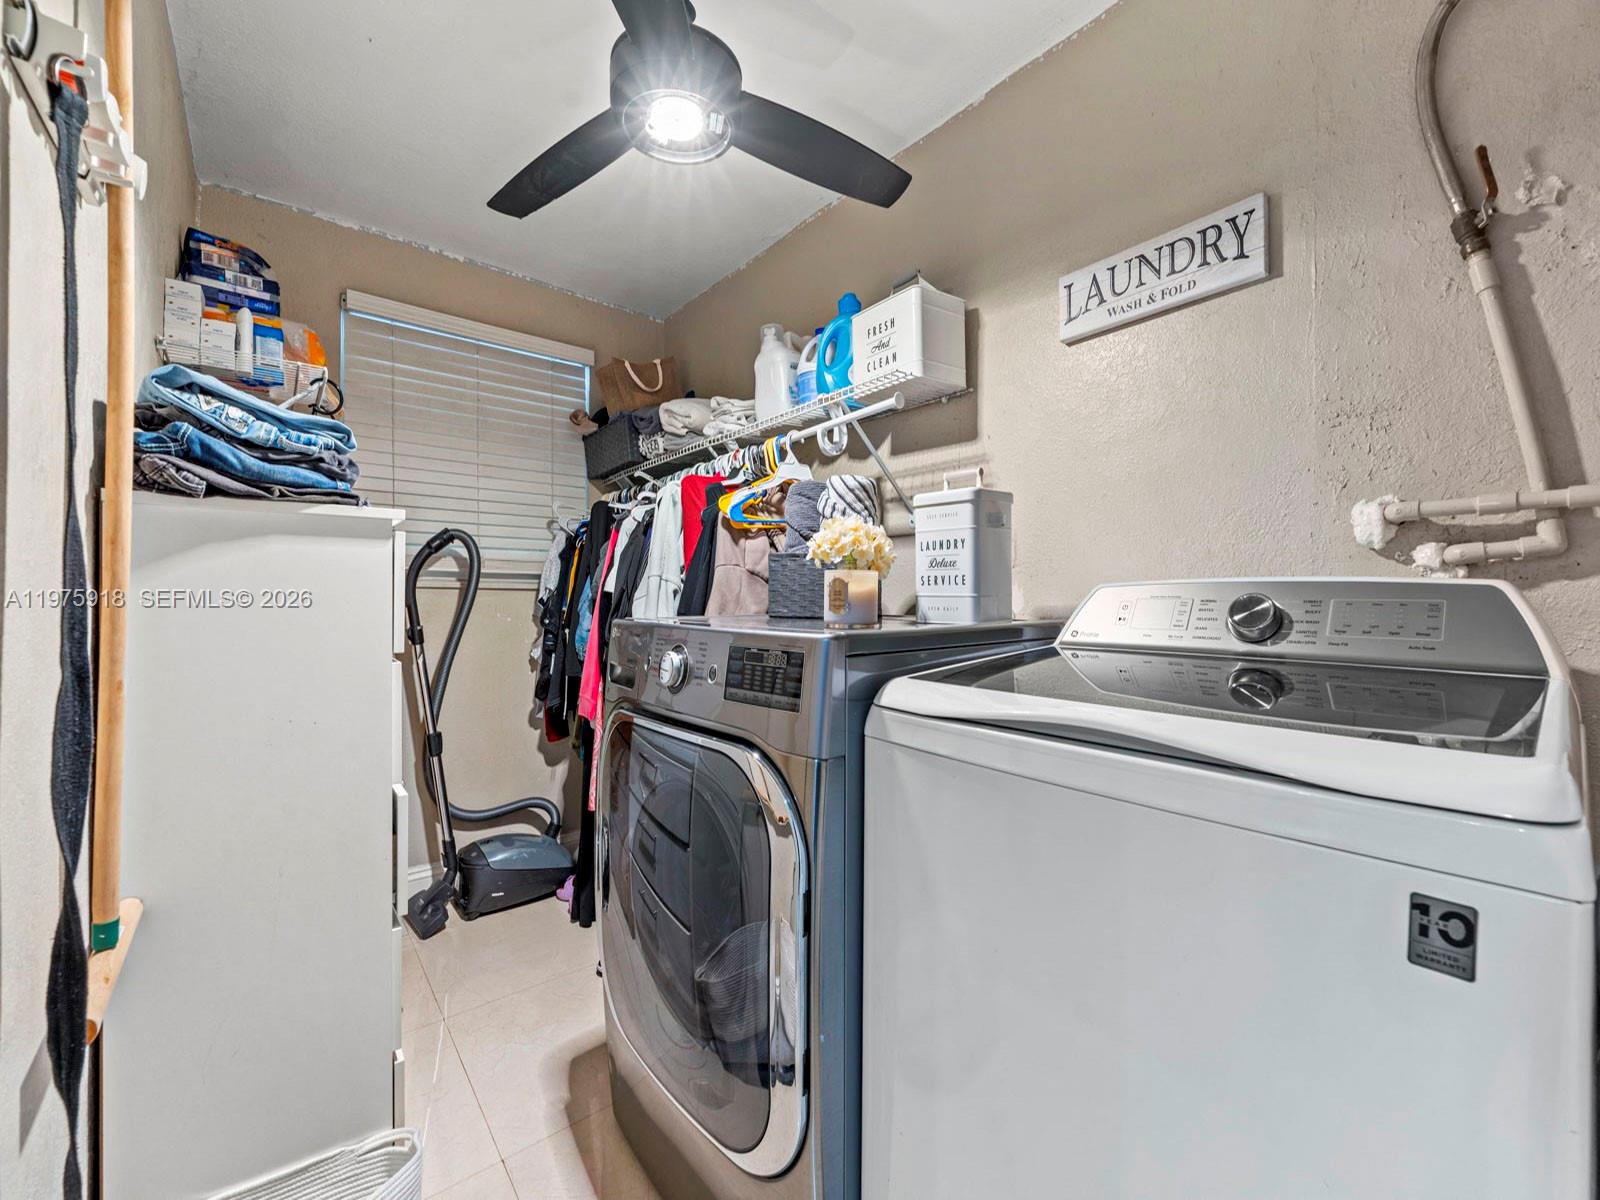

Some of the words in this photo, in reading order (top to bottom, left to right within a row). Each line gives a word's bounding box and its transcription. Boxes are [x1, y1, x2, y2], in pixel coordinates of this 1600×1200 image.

[1064, 208, 1255, 325] LAUNDRY
[1106, 298, 1142, 318] WASH
[1146, 292, 1157, 306] &
[1160, 280, 1197, 301] FOLD
[867, 317, 895, 339] FRESH
[871, 337, 891, 354] And
[867, 352, 897, 373] CLEAN
[920, 538, 966, 552] LAUNDRY
[928, 557, 958, 569] Deluxe
[920, 574, 966, 586] SERVICE
[1416, 953, 1466, 973] WARRANTY
[1423, 947, 1460, 962] LIMITED
